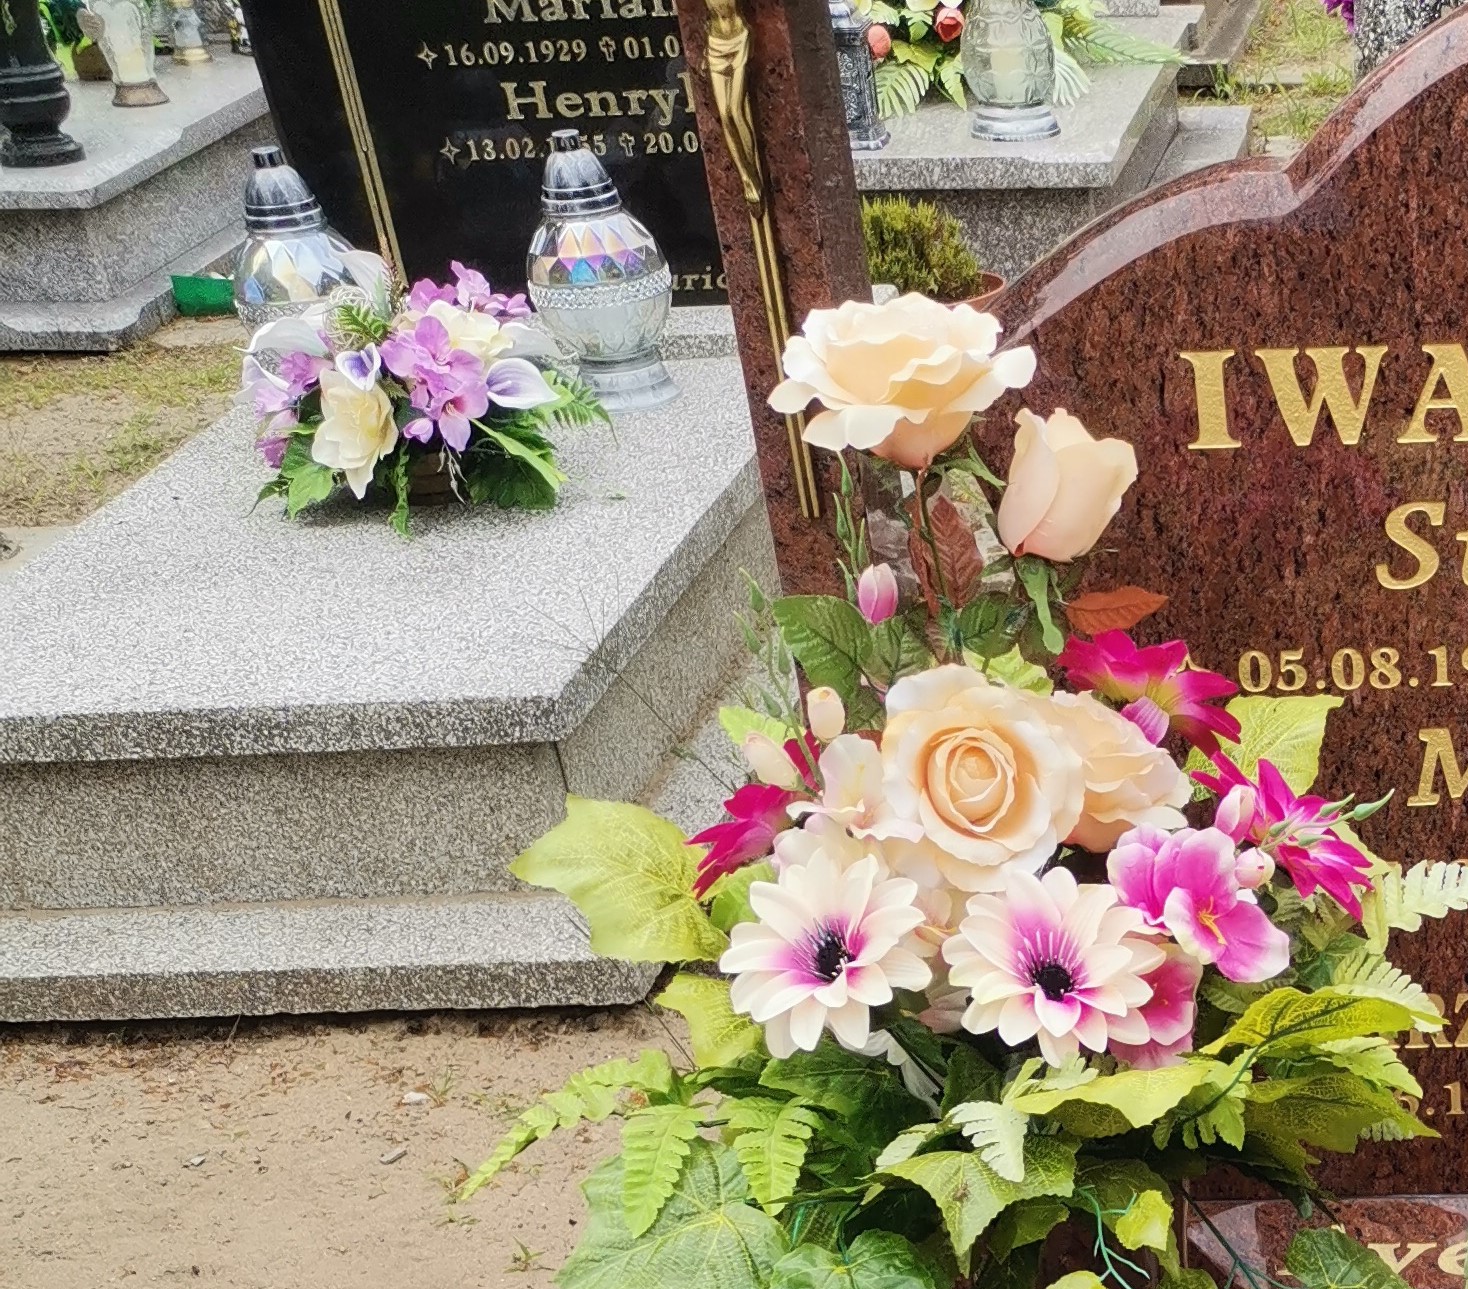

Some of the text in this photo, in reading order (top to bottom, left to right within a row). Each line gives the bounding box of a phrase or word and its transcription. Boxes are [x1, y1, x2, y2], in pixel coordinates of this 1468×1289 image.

[444, 35, 680, 67] 16.09.1929 01.0
[466, 131, 699, 162] 13.02.155 20.0
